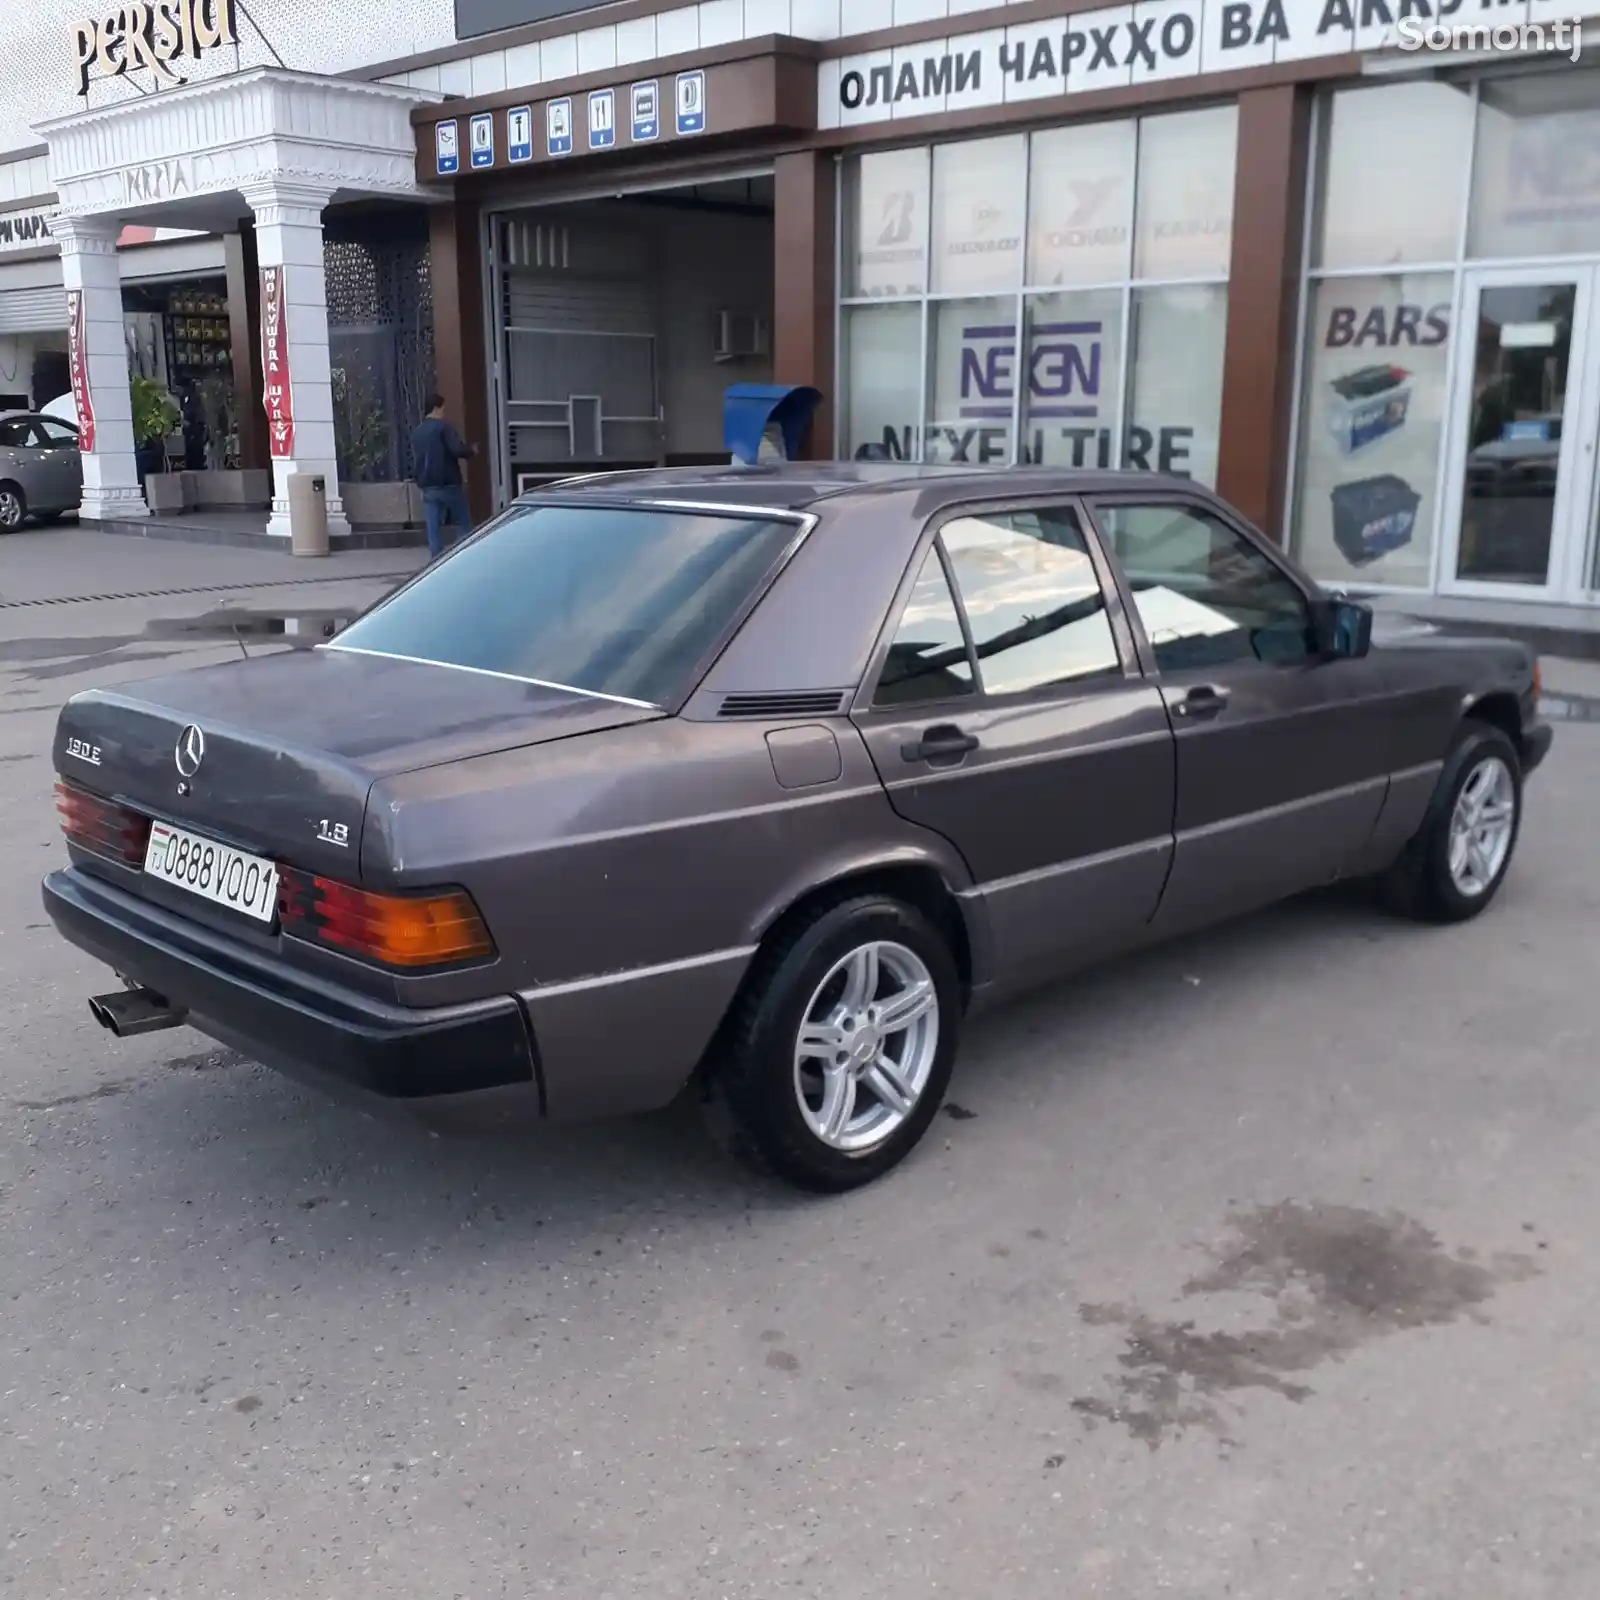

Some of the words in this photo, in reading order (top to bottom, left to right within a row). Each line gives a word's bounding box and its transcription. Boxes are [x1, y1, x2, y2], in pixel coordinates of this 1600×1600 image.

[840, 50, 982, 110] ОЛАМИ
[1000, 13, 1195, 82] ЧАРХҲО
[1221, 0, 1290, 49] ВА
[266, 302, 279, 372] КУШОДА
[1325, 302, 1450, 348] BARS
[1061, 425, 1194, 482] TIRE
[319, 819, 349, 842] 1.8
[164, 833, 273, 914] 0888VQ01
